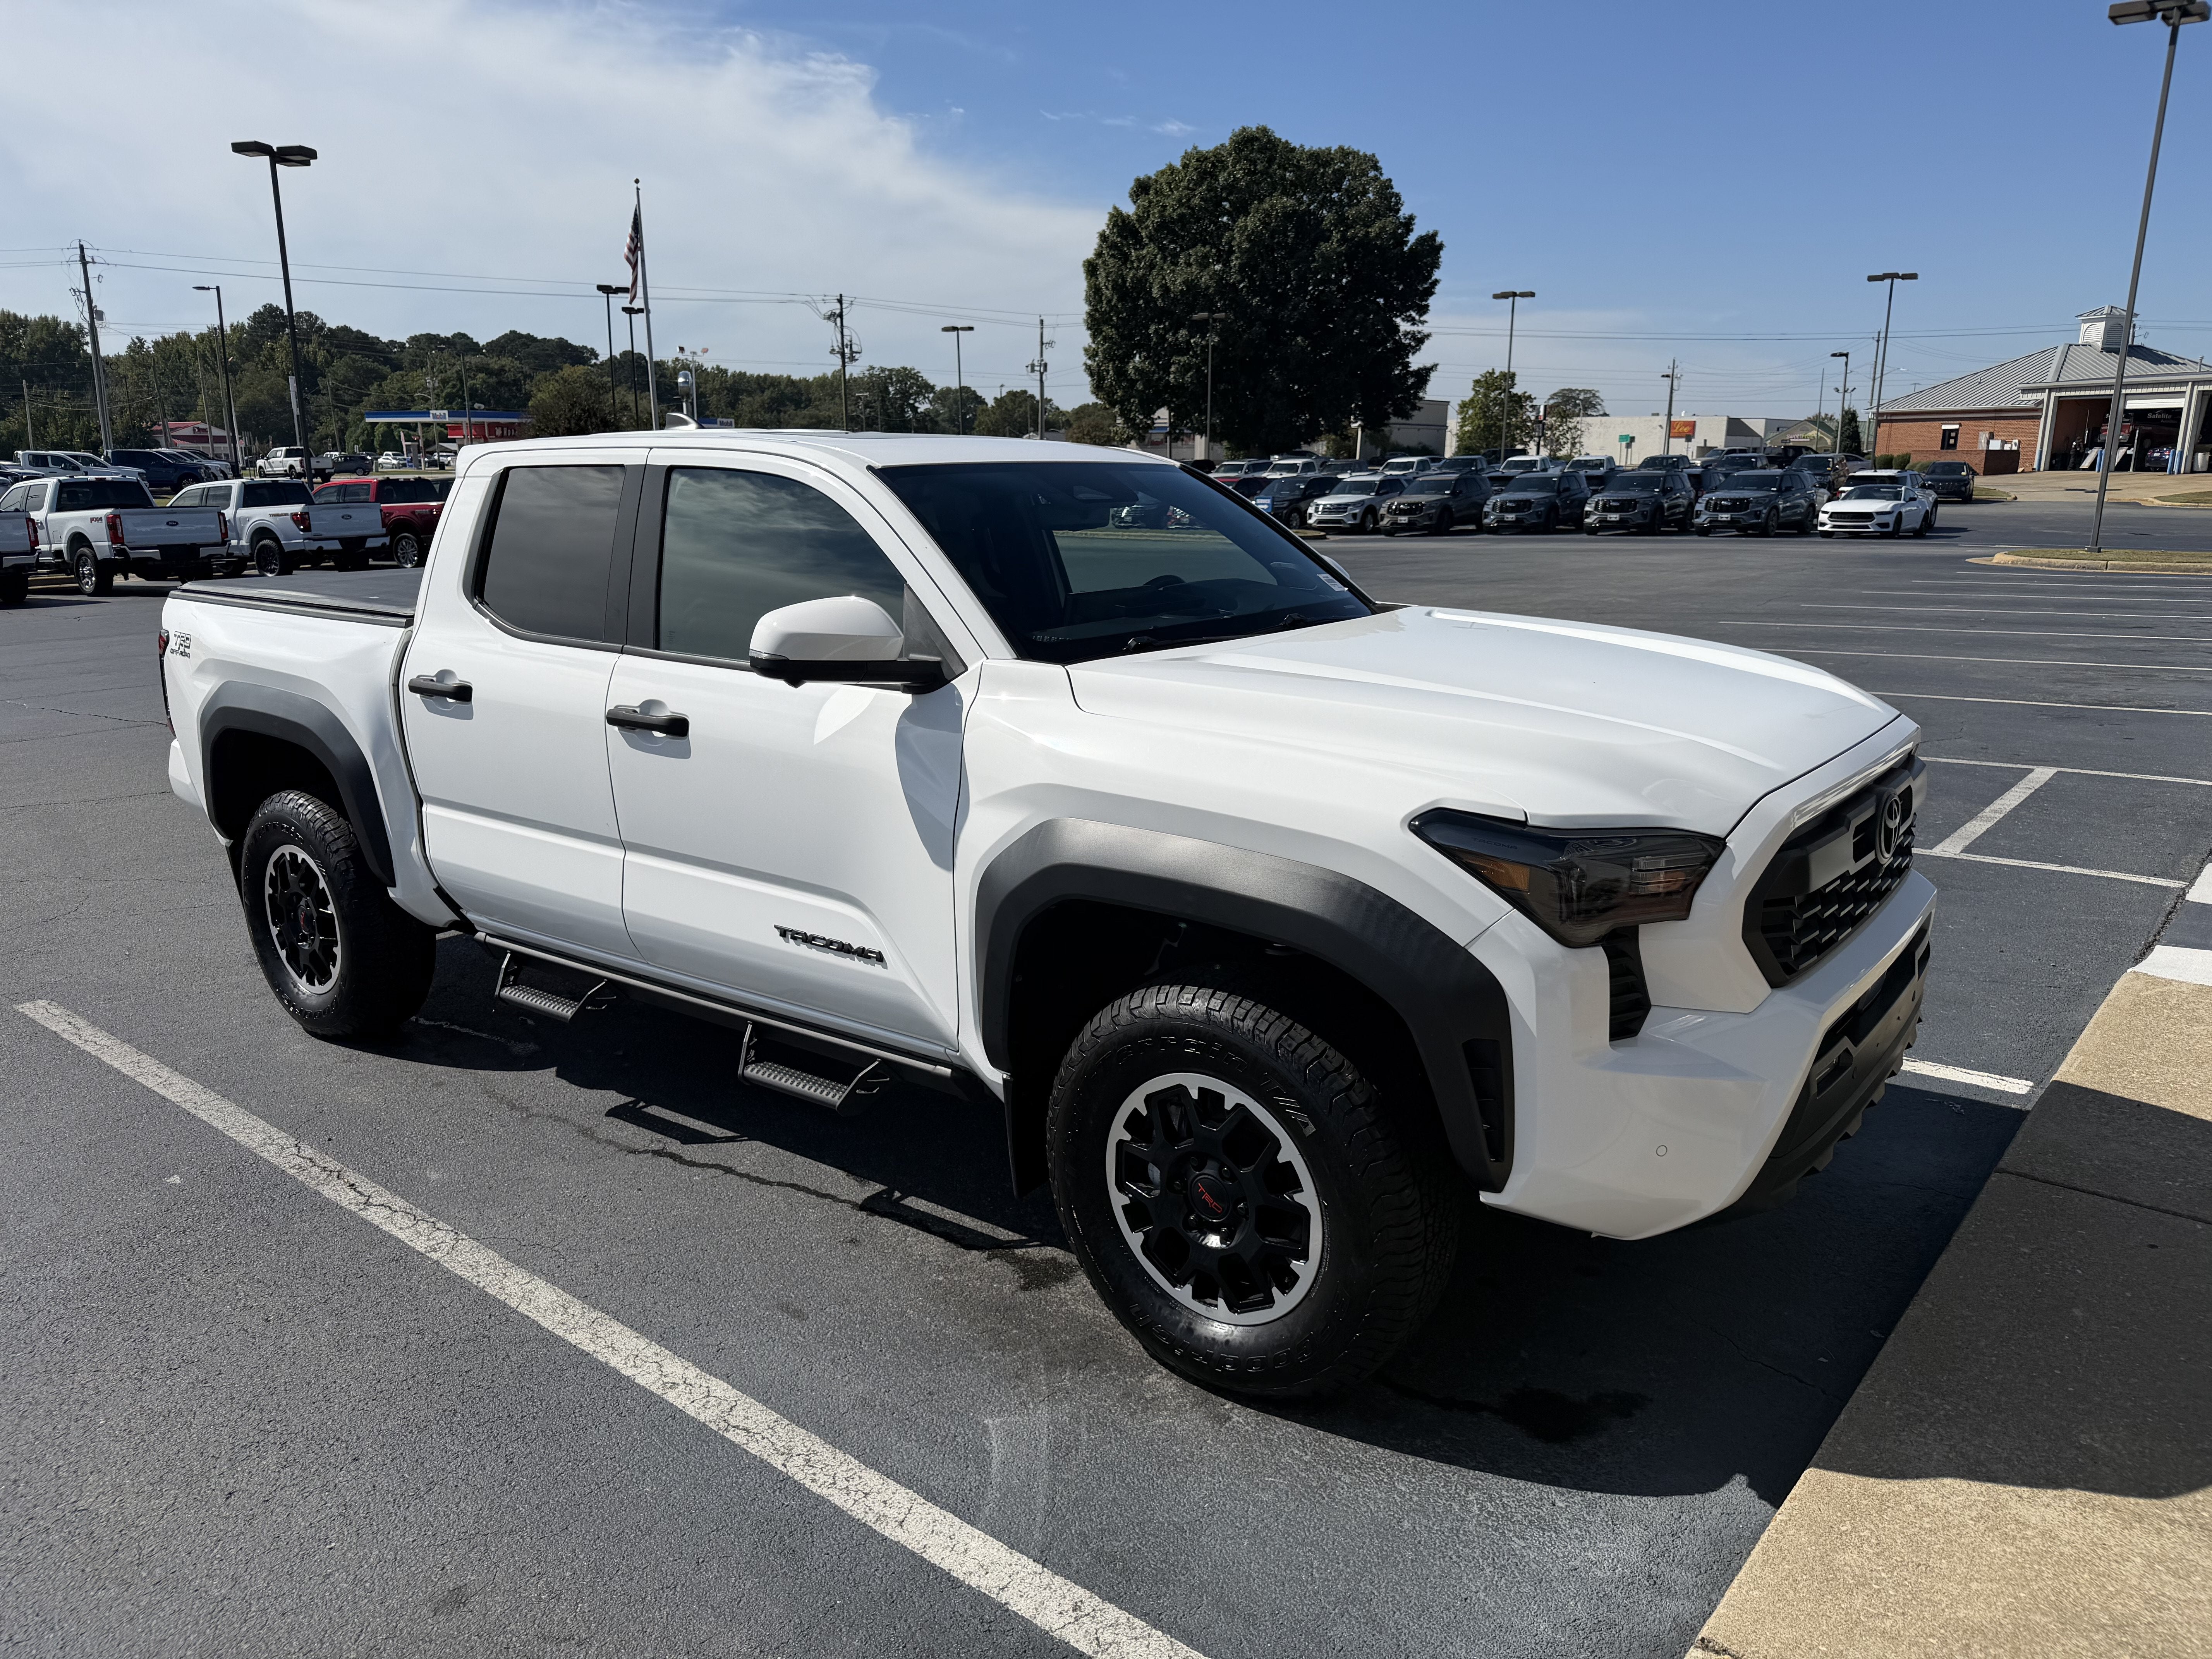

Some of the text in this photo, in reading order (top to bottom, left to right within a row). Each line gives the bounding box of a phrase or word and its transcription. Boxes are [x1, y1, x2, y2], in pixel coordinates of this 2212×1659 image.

[1674, 421, 1692, 433] Lee
[174, 631, 191, 651] TRD
[1472, 837, 1518, 850] TACOMA
[774, 924, 884, 963] TACOMA
[1198, 1183, 1222, 1213] TRD
